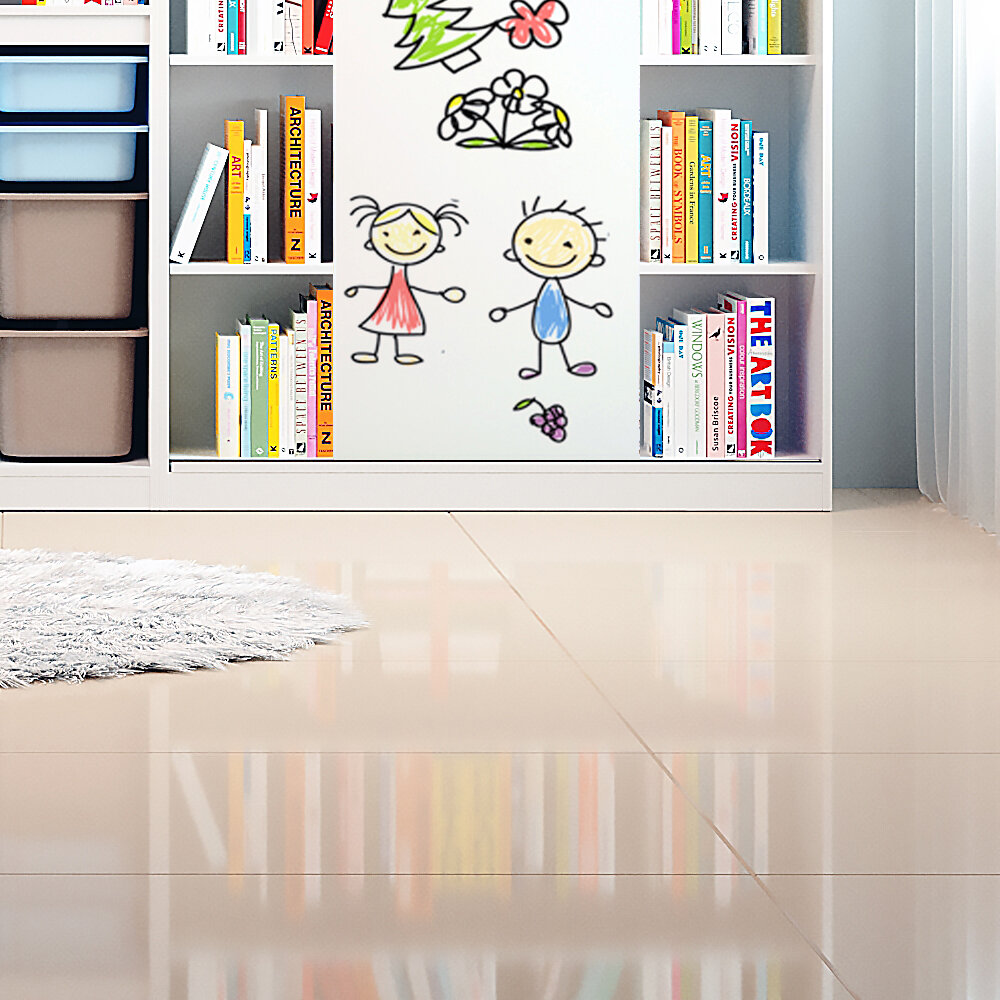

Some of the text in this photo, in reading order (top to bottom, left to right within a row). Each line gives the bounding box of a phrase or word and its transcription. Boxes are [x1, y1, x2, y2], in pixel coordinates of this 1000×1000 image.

[289, 107, 301, 218] ARCHITECTURE
[674, 149, 683, 179] BOOK
[731, 123, 739, 162] VISION
[231, 155, 241, 178] ART
[650, 146, 660, 199] BETWEEN
[701, 154, 712, 179] ART
[674, 190, 683, 244] SYMBOLS
[727, 317, 735, 355] VISION
[750, 301, 772, 346] THE
[296, 339, 306, 393] BETWEEN
[320, 300, 332, 411] ARCHITECTURE
[692, 320, 703, 378] WINDOWS
[750, 356, 772, 399] ART
[711, 396, 719, 425] Briscoe
